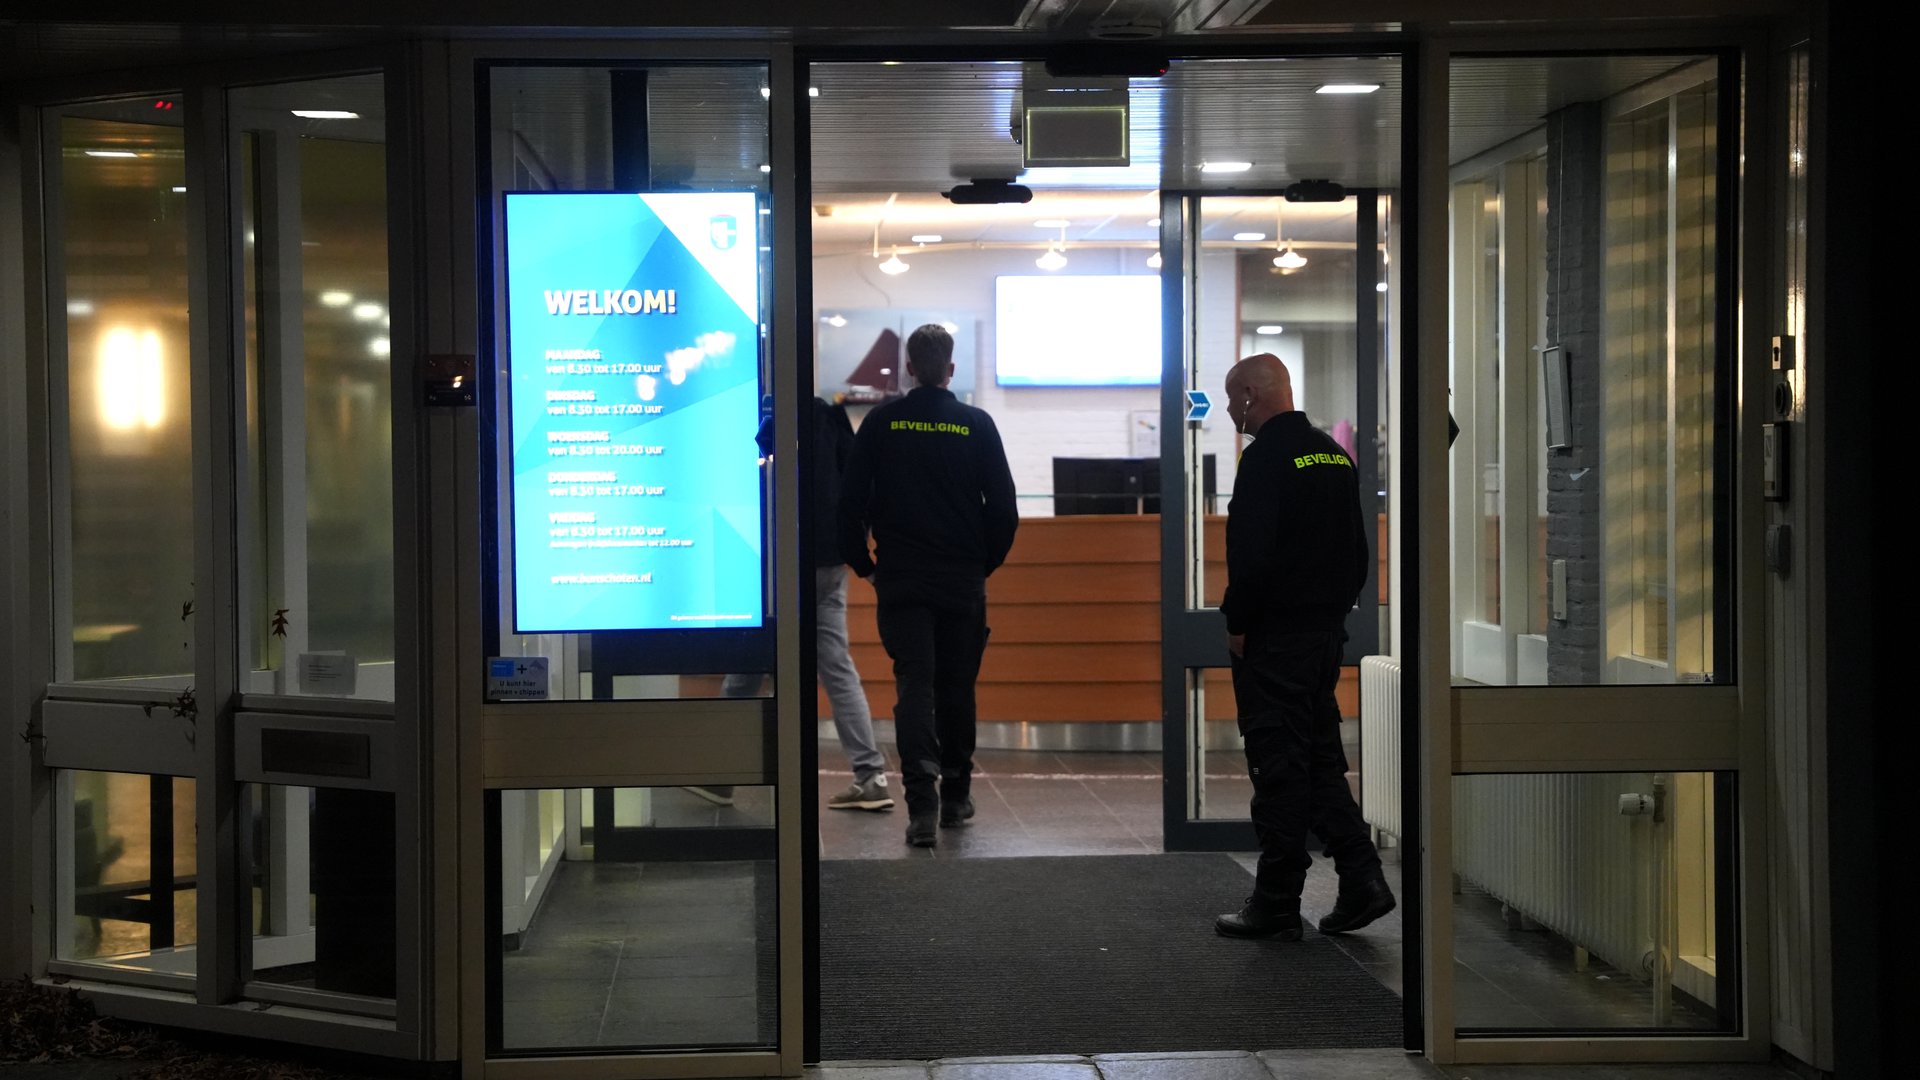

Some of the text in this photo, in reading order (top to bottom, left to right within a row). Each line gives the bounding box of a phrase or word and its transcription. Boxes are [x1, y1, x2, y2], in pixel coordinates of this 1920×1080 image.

[544, 289, 677, 316] WELKOM!
[545, 349, 601, 360] MAANDAG
[546, 363, 662, 374] van 8.30 tot 17.00 uur
[547, 404, 663, 415] van 8.30 tot 17.00 uur
[890, 420, 970, 436] BEVEILIGING
[548, 446, 567, 455] van
[595, 445, 610, 455] tot
[613, 445, 643, 455] 20.00
[645, 446, 663, 454] uur
[1294, 453, 1352, 469] BEVEILIGIN
[548, 487, 568, 496] van
[596, 486, 611, 495] tot
[613, 485, 644, 495] 17.00
[646, 486, 665, 495] uur
[549, 528, 569, 537] van
[597, 527, 612, 536] tot
[614, 526, 645, 536] 17.00
[647, 527, 665, 535] uur
